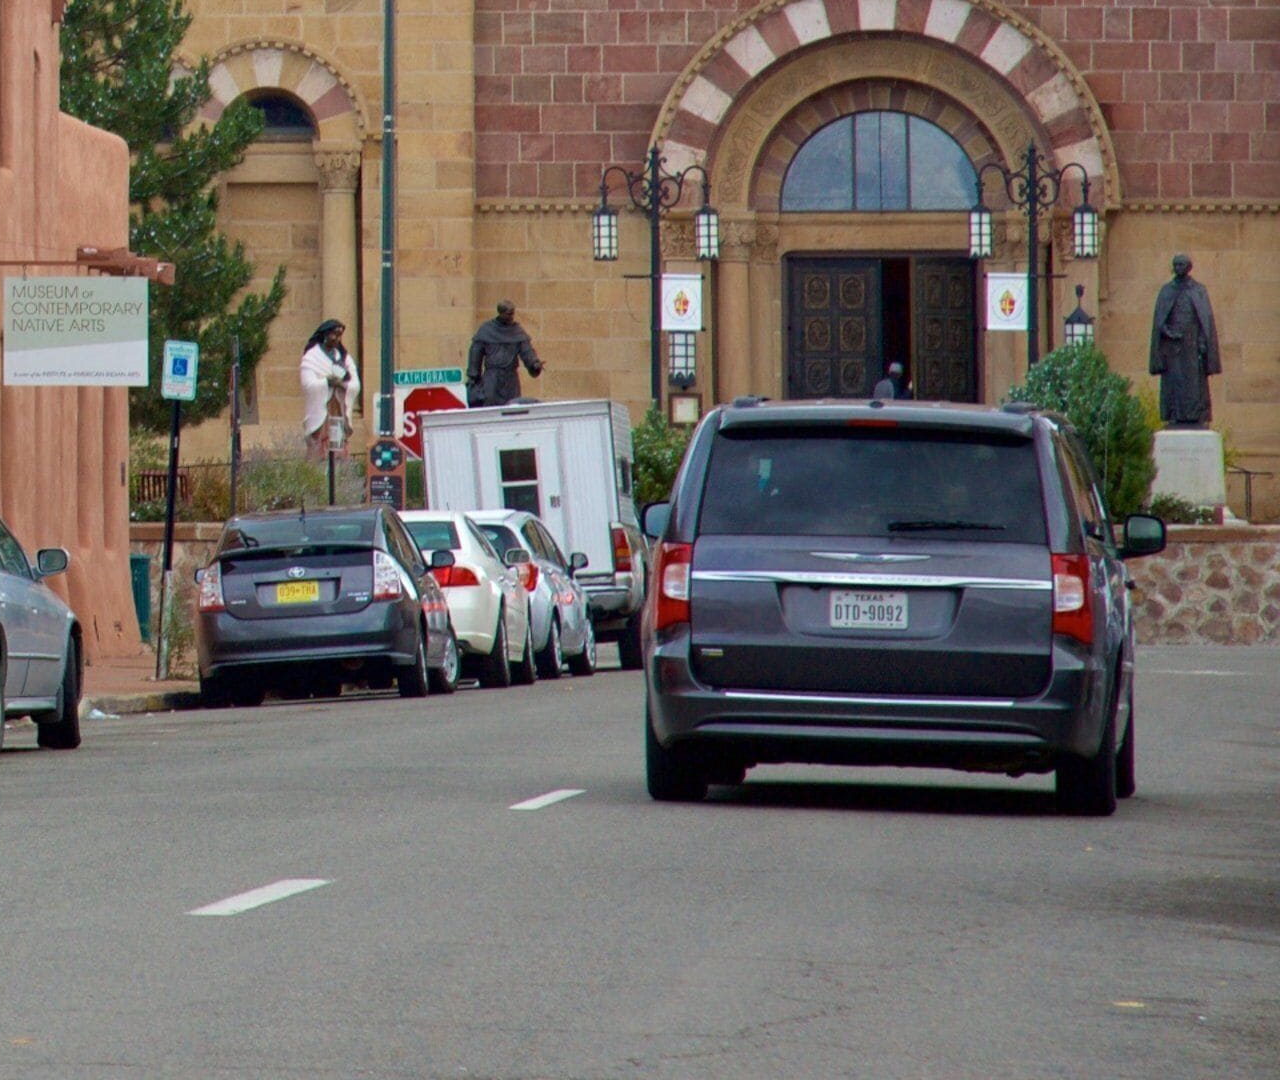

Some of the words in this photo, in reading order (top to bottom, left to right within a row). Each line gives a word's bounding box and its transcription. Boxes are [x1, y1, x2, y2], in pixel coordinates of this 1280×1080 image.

[12, 285, 79, 299] MUSEUM
[11, 301, 144, 316] CONTEMPORARY
[12, 318, 65, 332] NATIVE
[68, 318, 106, 333] ARTS
